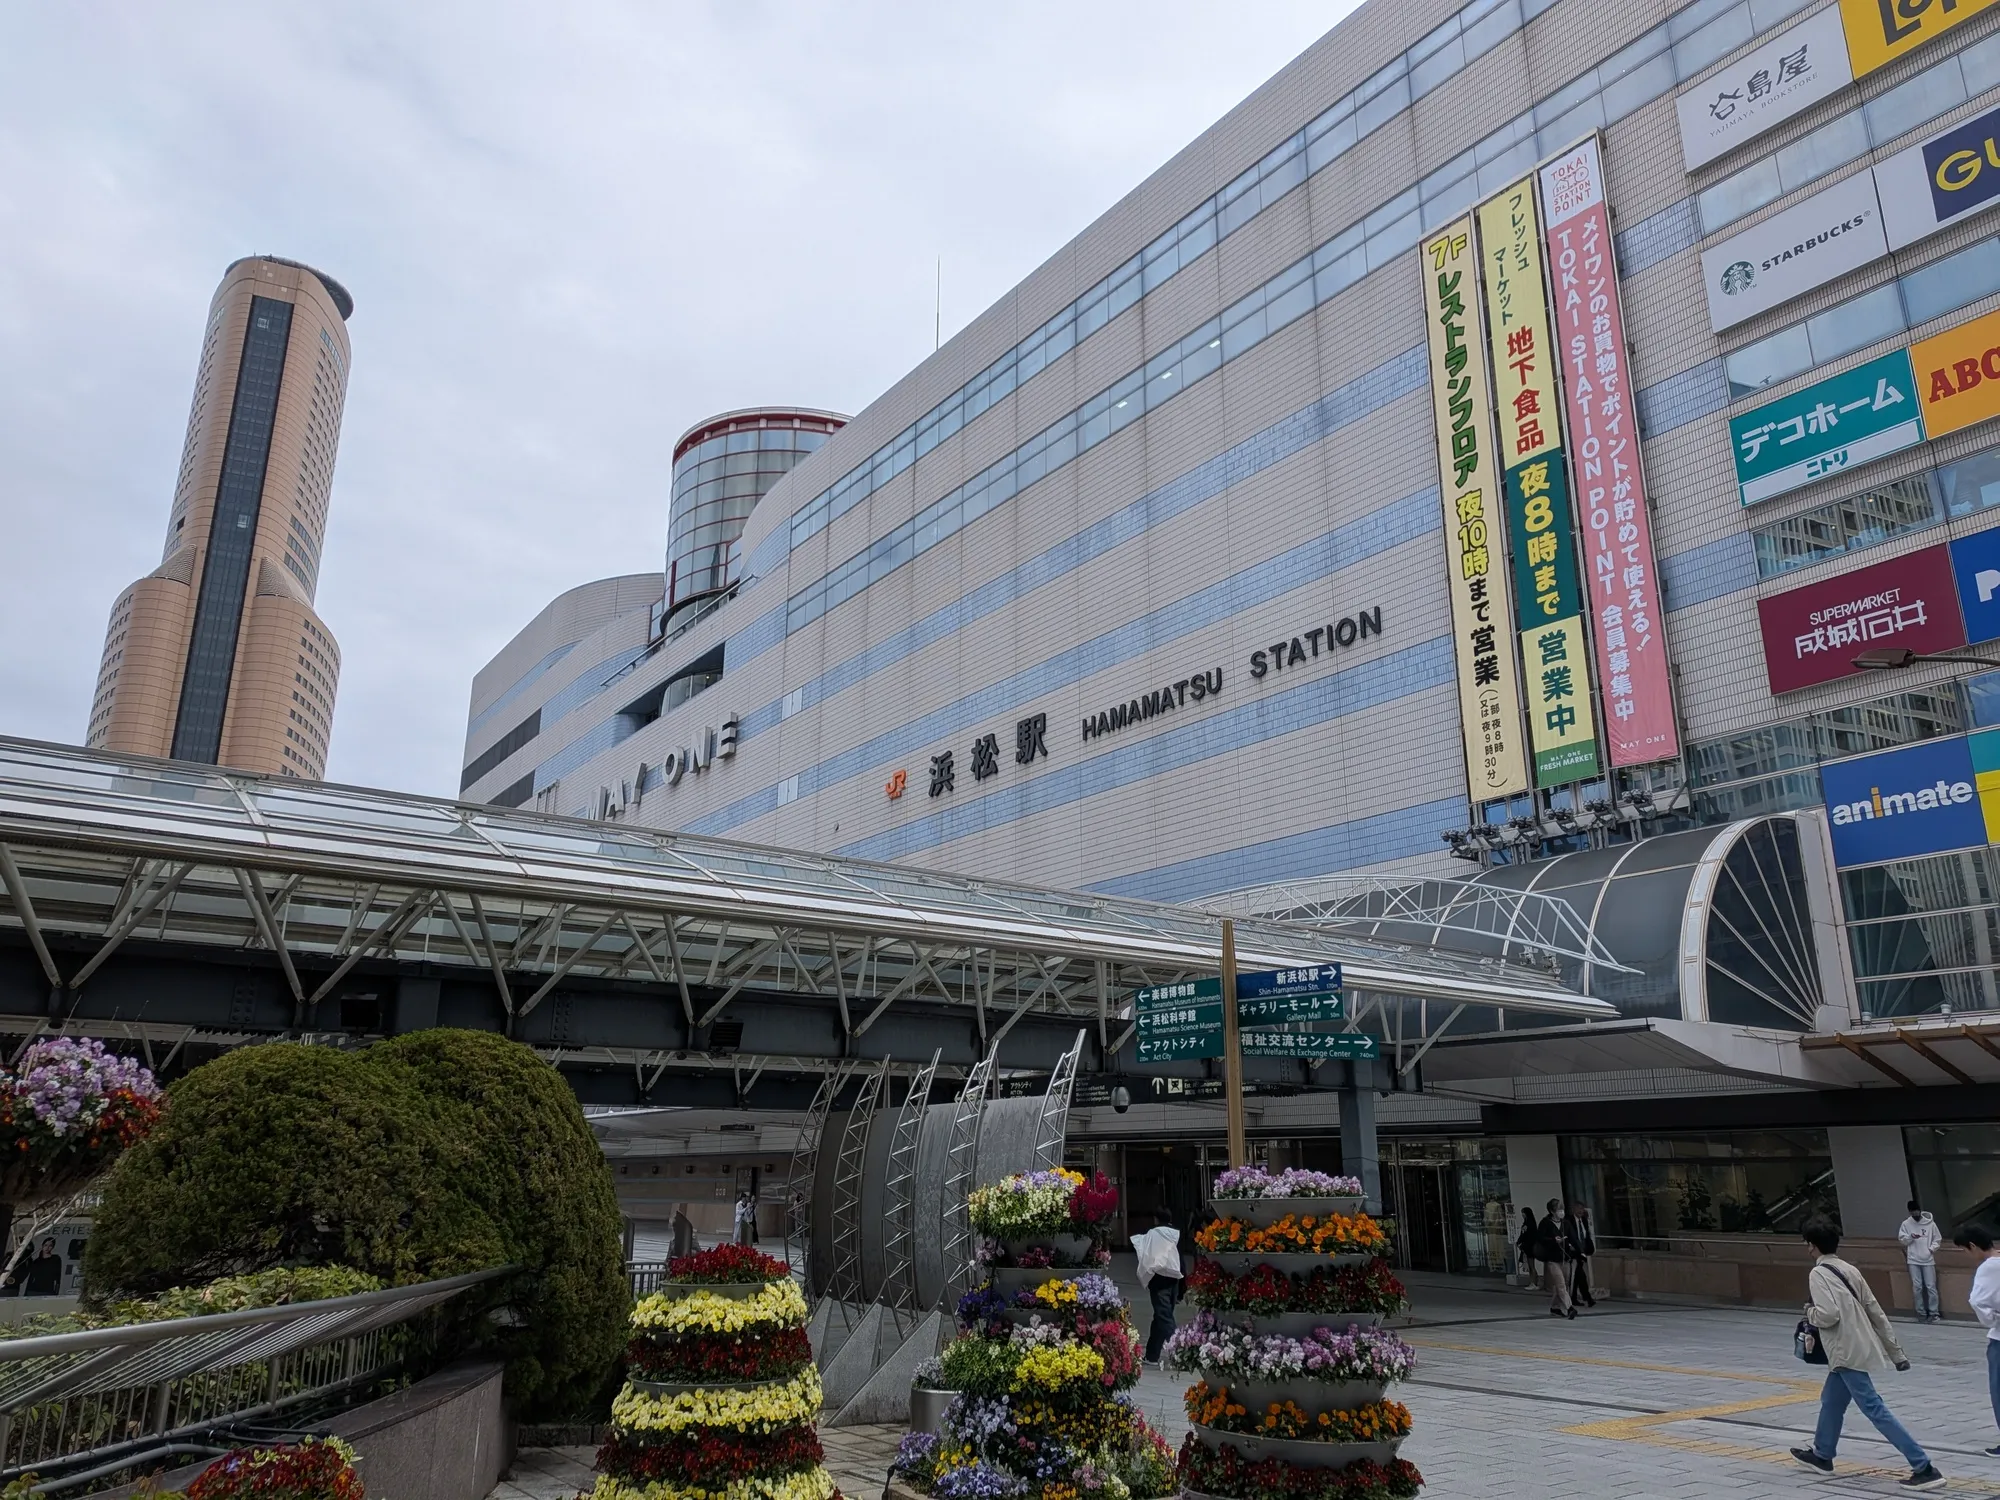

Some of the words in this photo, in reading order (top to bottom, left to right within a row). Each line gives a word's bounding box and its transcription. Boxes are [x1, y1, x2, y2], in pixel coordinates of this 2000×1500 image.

[1709, 43, 1811, 120] 谷島屋
[1709, 108, 1754, 138] YAJIMAYA
[1761, 73, 1818, 108] BOOKSTORE
[1551, 153, 1588, 180] TOKAI
[1554, 180, 1591, 206] STATION
[1554, 188, 1591, 216] POINT
[1509, 193, 1530, 271] フレッシュ
[1428, 232, 1467, 272] 7F
[1494, 247, 1513, 326] マーケット
[1557, 228, 1582, 327] TOKAI
[1437, 270, 1479, 489] レストランフロア
[1506, 324, 1545, 456] 地下食品
[1571, 334, 1602, 480] STATION
[1741, 378, 1905, 463] デコホーム
[1806, 450, 1849, 478] ニトリ
[1518, 461, 1561, 616] 夜8時まで
[1589, 487, 1618, 595] POINT
[1810, 588, 1901, 626] SUPERMARKET
[1794, 599, 1927, 659] 成城石井
[1601, 604, 1635, 722] 会員募集中
[929, 712, 1048, 796] 浜松駅
[1082, 667, 1223, 742] HAMAMATSU
[1250, 606, 1383, 678] STATION
[1538, 629, 1576, 737] 営業中
[1620, 739, 1640, 750] MAY
[1646, 734, 1666, 744] ONE
[586, 763, 647, 820] MAY
[662, 711, 739, 786] ONE
[885, 768, 907, 794] JR
[1540, 761, 1562, 772] FRESH
[1563, 753, 1594, 767] MARKET
[1832, 780, 1973, 826] animate
[1152, 983, 1195, 1001] 楽器博物館
[1258, 984, 1307, 995] Shin-Hamamatsu
[1308, 983, 1319, 991] Stn.
[1276, 968, 1319, 985] 新浜松駅
[1152, 1010, 1196, 1026] 浜松科学館
[1239, 998, 1320, 1016] ギャラリーモール
[1286, 1013, 1307, 1022] Gallery
[1308, 1011, 1321, 1019] Mall
[1152, 1026, 1180, 1034] Hamamatsu
[1180, 1023, 1198, 1031] Science
[1153, 1037, 1205, 1051] アクトシティ
[1241, 1033, 1349, 1047] 福祉交流センター
[1162, 1053, 1172, 1061] City
[1297, 1049, 1327, 1058] Exchange
[1329, 1049, 1351, 1057] Center
